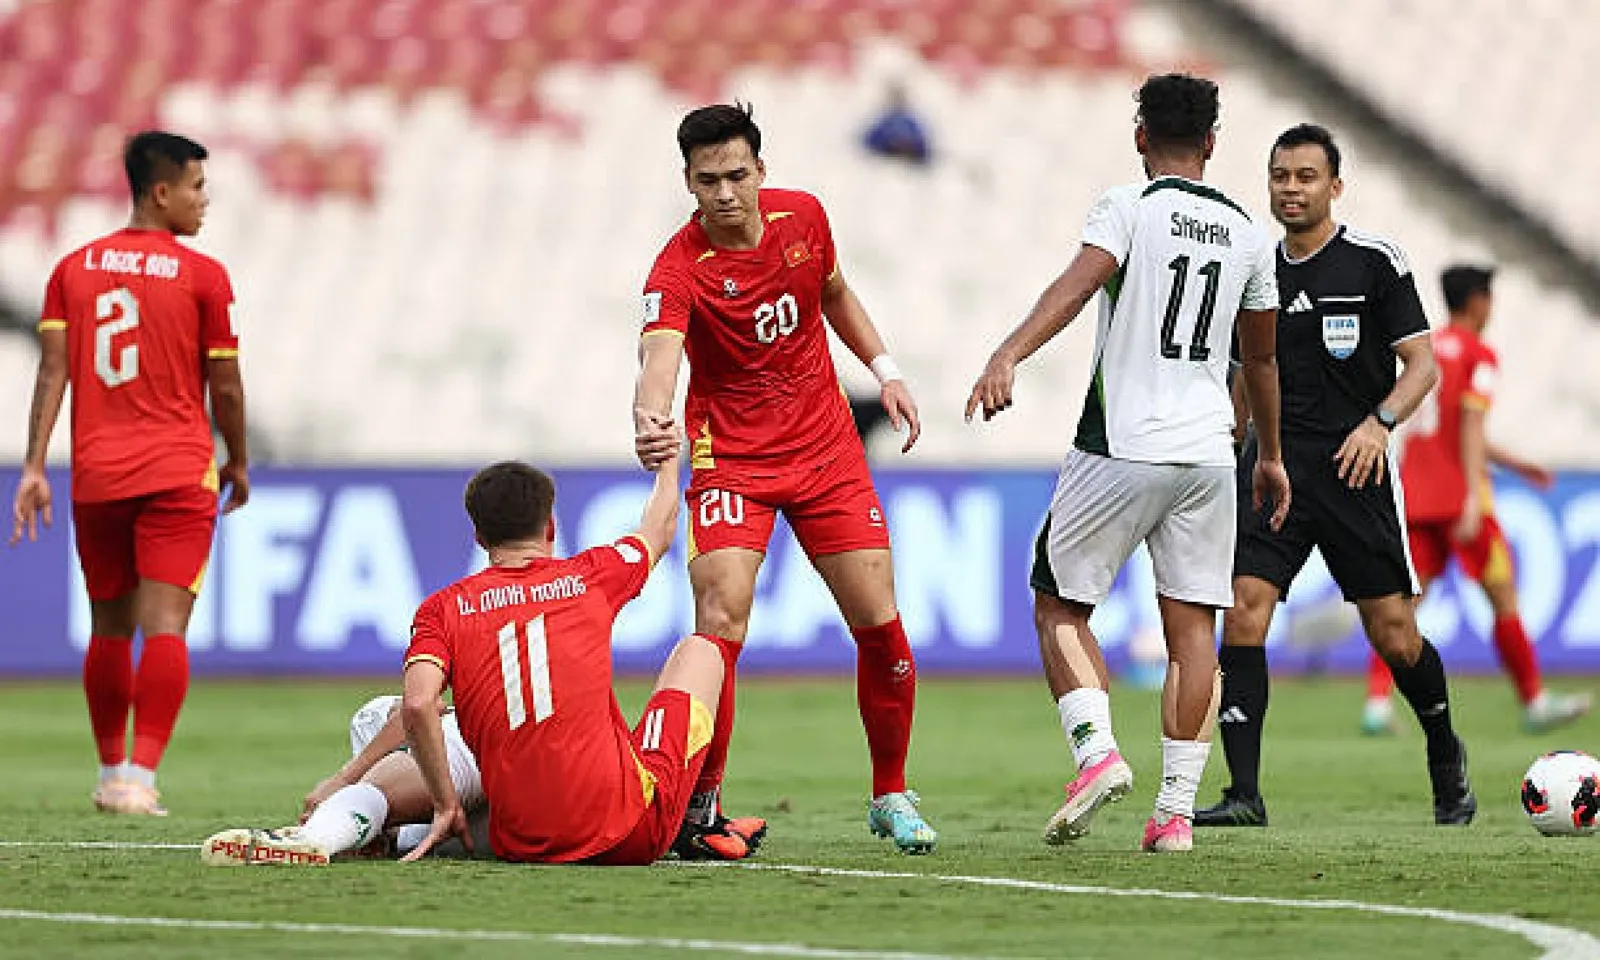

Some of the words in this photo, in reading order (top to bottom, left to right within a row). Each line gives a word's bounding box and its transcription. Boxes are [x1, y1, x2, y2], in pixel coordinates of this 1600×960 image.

[95, 287, 140, 388] 2
[754, 292, 799, 343] 20
[1160, 254, 1222, 361] 11
[699, 487, 745, 527] 20
[67, 485, 422, 650] FA
[498, 612, 555, 731] 11
[641, 708, 665, 750] 11
